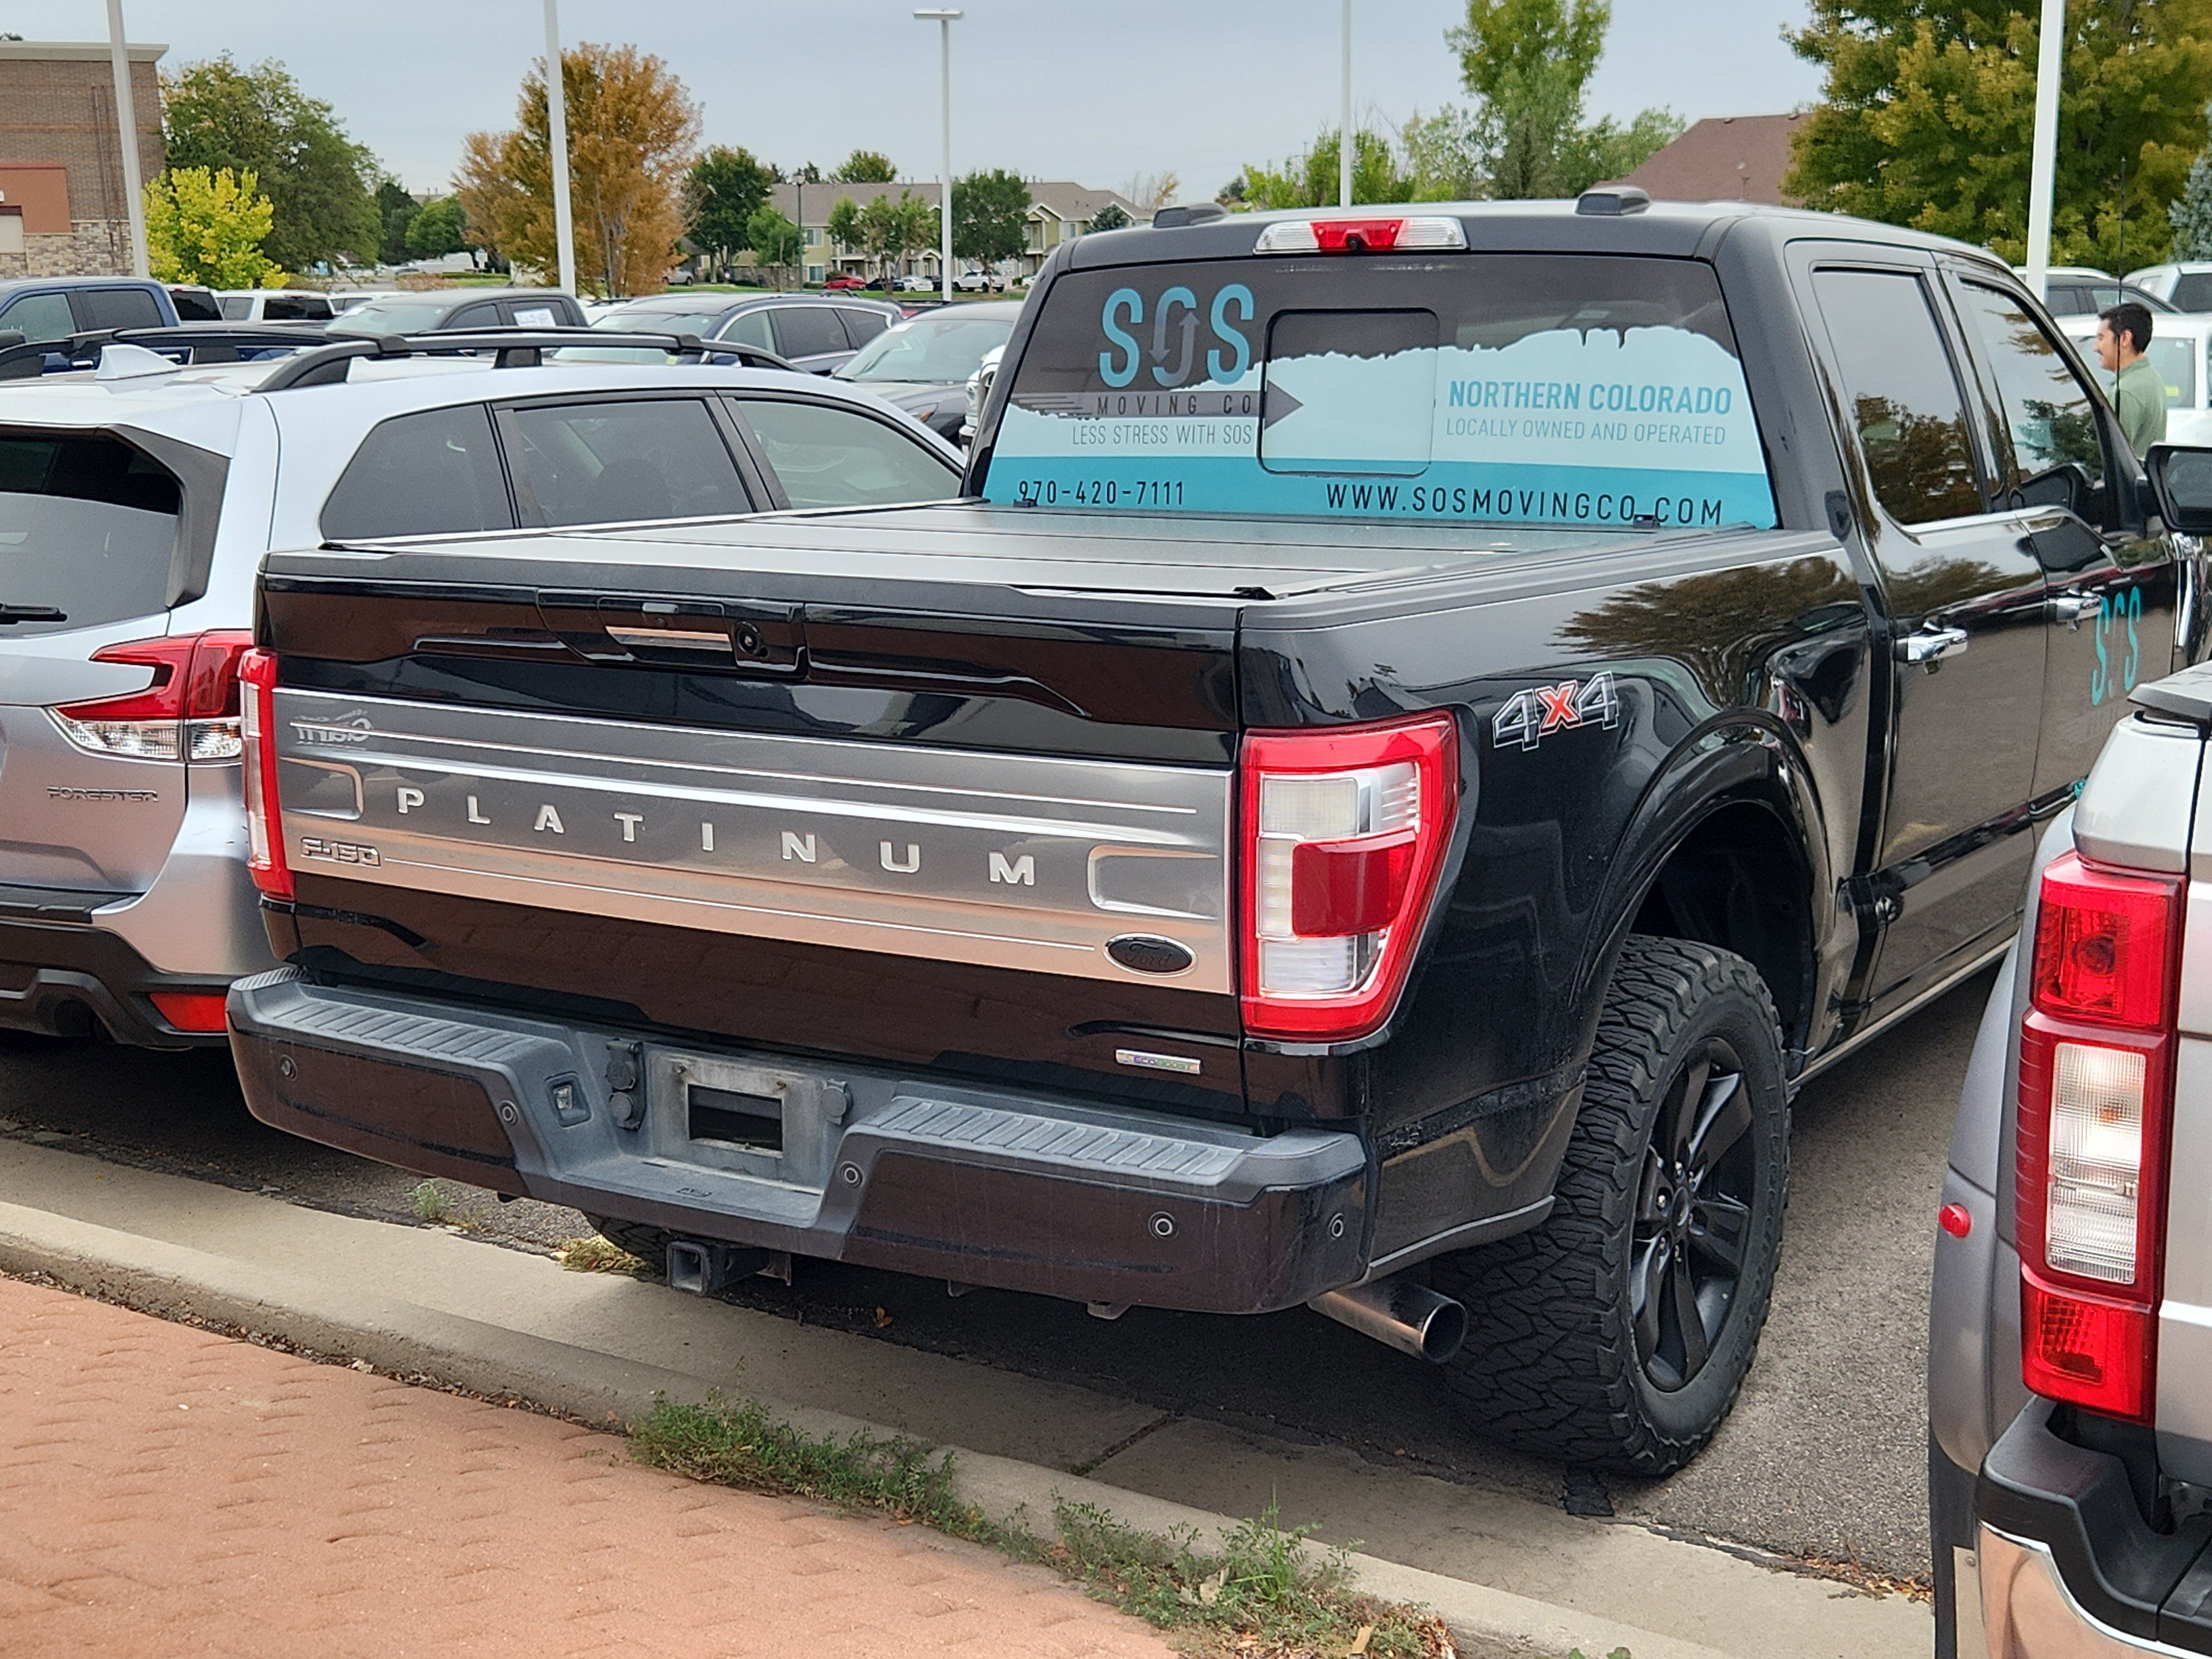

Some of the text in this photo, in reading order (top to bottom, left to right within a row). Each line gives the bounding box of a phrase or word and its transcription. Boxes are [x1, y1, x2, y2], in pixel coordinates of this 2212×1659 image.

[1099, 283, 1254, 388] SOS
[1097, 394, 1251, 415] MOVING CO
[1448, 381, 1732, 415] NORTHERN COLORADO
[1072, 425, 1252, 445] LESS STRESS WITH SOS
[1446, 417, 1726, 446] LOCALLY OWNED AND OPERATED
[1018, 480, 1183, 505] 970-420-7111
[1326, 484, 1722, 525] WWW.SOSMOVINGCOCOM
[47, 786, 159, 801] FORESTER
[397, 787, 1036, 887] PLATINUM
[301, 837, 381, 869] F-150
[1123, 941, 1173, 968] Ford
